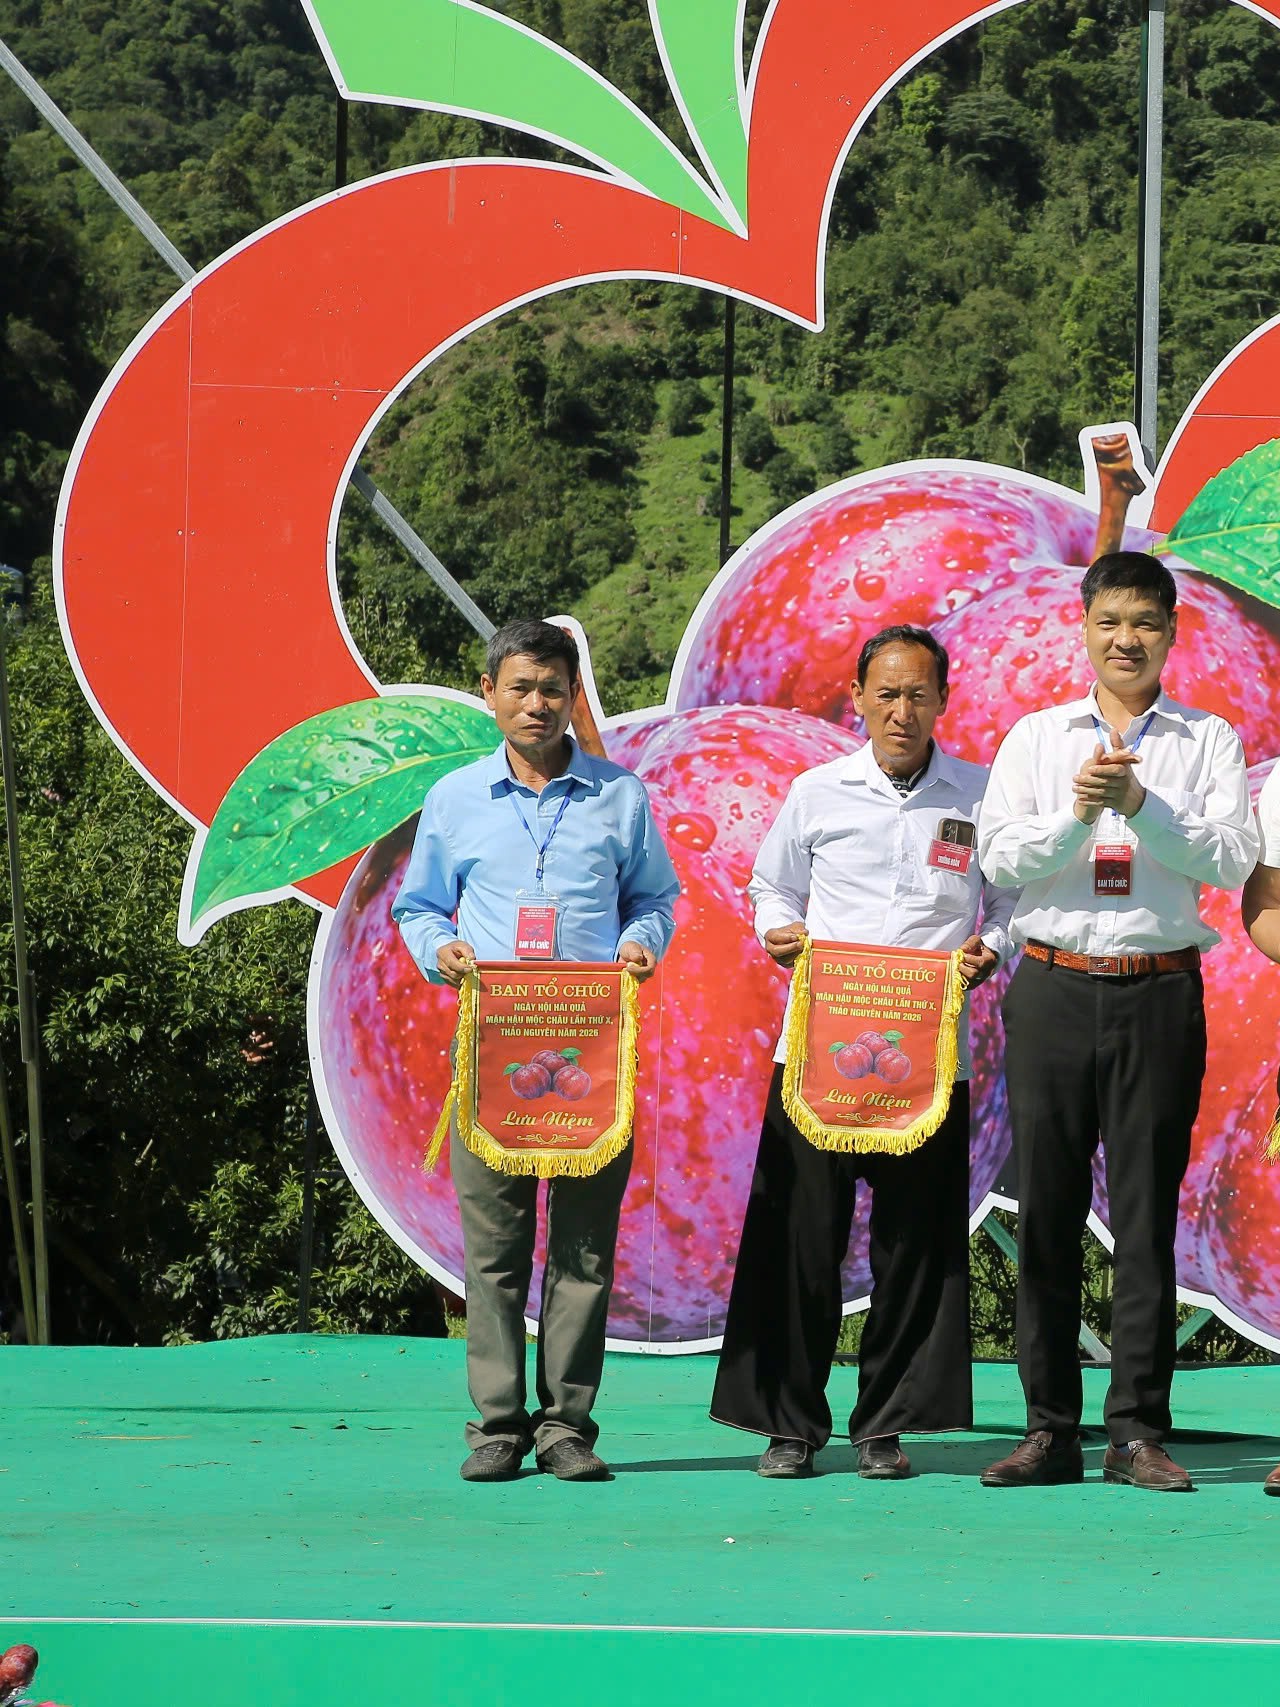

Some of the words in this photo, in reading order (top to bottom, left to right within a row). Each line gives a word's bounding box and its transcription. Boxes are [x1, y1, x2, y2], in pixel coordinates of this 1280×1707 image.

[821, 962, 859, 976] BAN
[863, 960, 886, 979] TỔ
[890, 966, 937, 983] CHỨC
[490, 984, 529, 997] BAN
[534, 977, 559, 997] TỔ
[562, 982, 611, 998] CHỨC
[843, 981, 864, 991] NGÀY
[865, 983, 879, 993] HỘI
[881, 983, 894, 993] HÁI
[896, 985, 911, 995] QUẢ
[514, 1002, 536, 1012] NGÀY
[538, 1002, 552, 1013] HỘI
[553, 1002, 568, 1012] HÁI
[569, 1001, 586, 1012] QUẢ
[815, 992, 834, 1003] MẬN
[835, 993, 852, 1004] HẬU
[853, 995, 871, 1005] MỘC
[873, 997, 894, 1007] CHÂU
[912, 999, 928, 1009] THỨ
[485, 1014, 505, 1025] MẬN
[507, 1014, 524, 1026] HẬU
[526, 1014, 545, 1026] MỘC
[546, 1015, 568, 1024] CHÂU
[587, 1015, 605, 1025] THỨ
[828, 1004, 848, 1015] THẢO
[850, 1007, 881, 1018] NGUYÊN
[882, 1009, 901, 1020] NĂM
[902, 1013, 922, 1022] 2026
[500, 1026, 521, 1036] THẢO
[523, 1027, 556, 1037] NGUYÊN
[557, 1027, 577, 1037] NĂM
[579, 1029, 599, 1037] 2026
[822, 1088, 857, 1105] Lưu
[862, 1091, 912, 1110] Niệm
[500, 1110, 537, 1126] Lưu
[542, 1110, 594, 1130] Niệm
